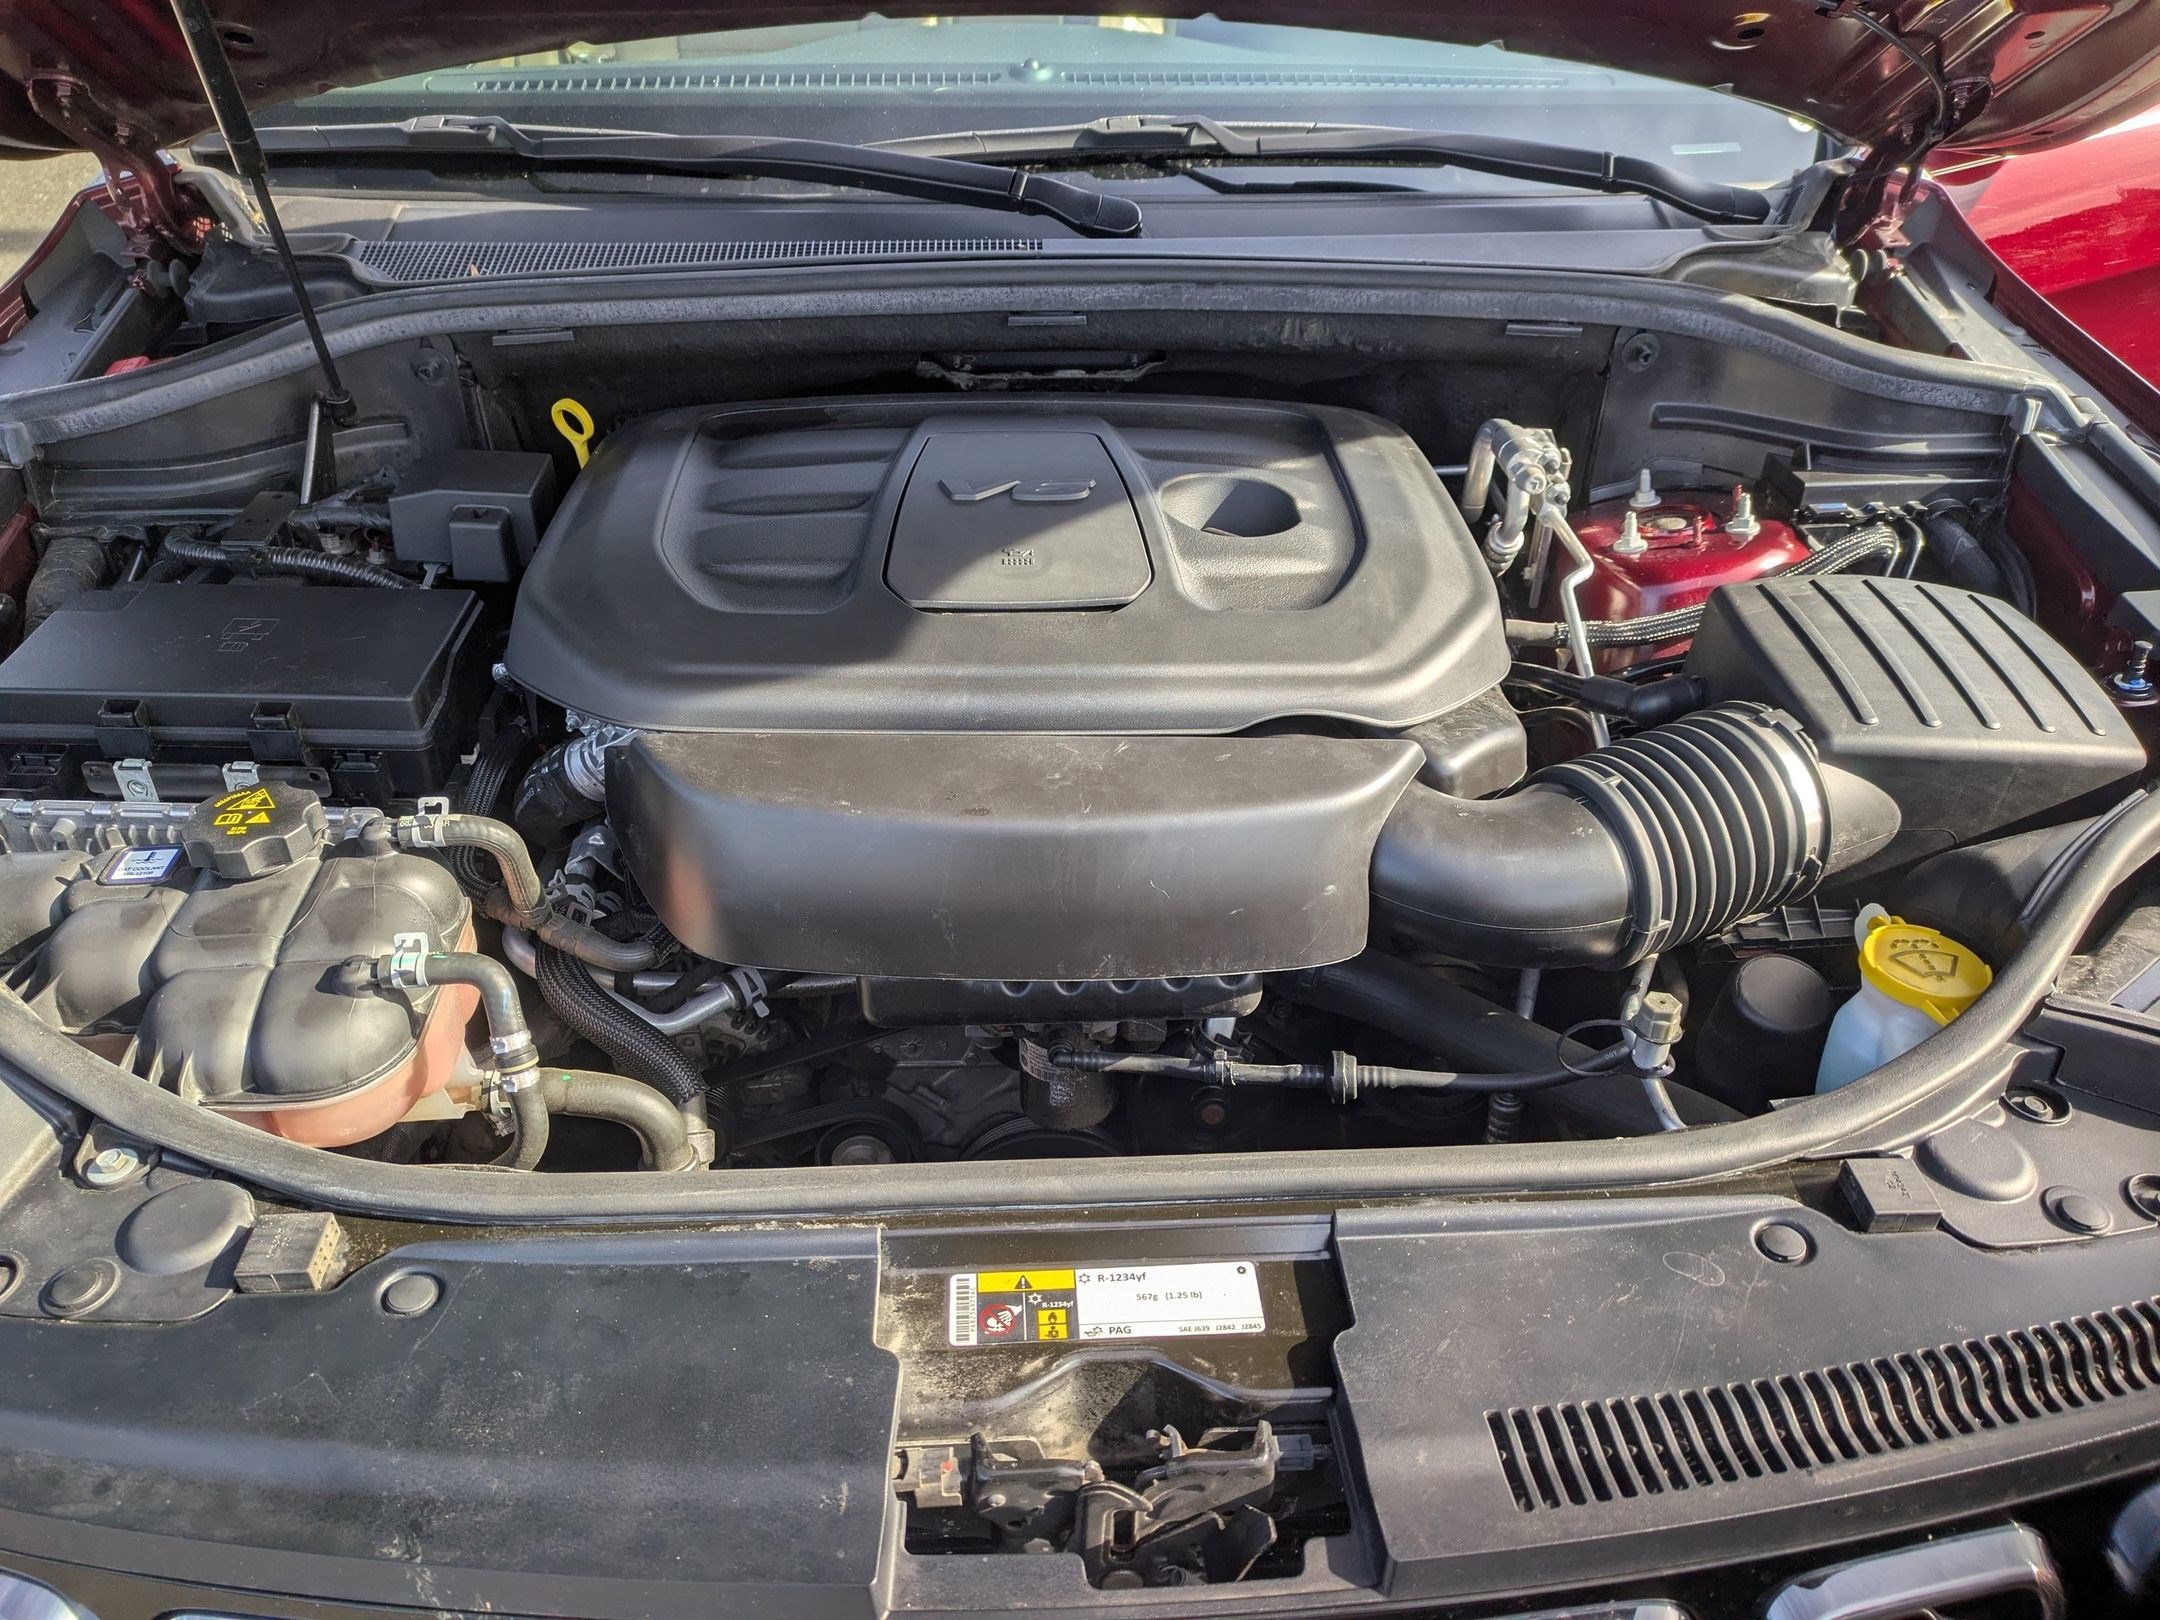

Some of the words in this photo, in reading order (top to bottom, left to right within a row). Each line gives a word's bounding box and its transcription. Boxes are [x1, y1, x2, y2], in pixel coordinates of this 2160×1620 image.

[936, 479, 1097, 501] V6
[1098, 1271, 1146, 1282] R-1234yf
[1136, 1292, 1159, 1302] 567g
[1165, 1291, 1188, 1301] (1.25
[1190, 1290, 1203, 1300] lb)
[1041, 1300, 1074, 1309] R-1234yf
[1109, 1325, 1132, 1335] PAG
[1178, 1325, 1193, 1333] SAE
